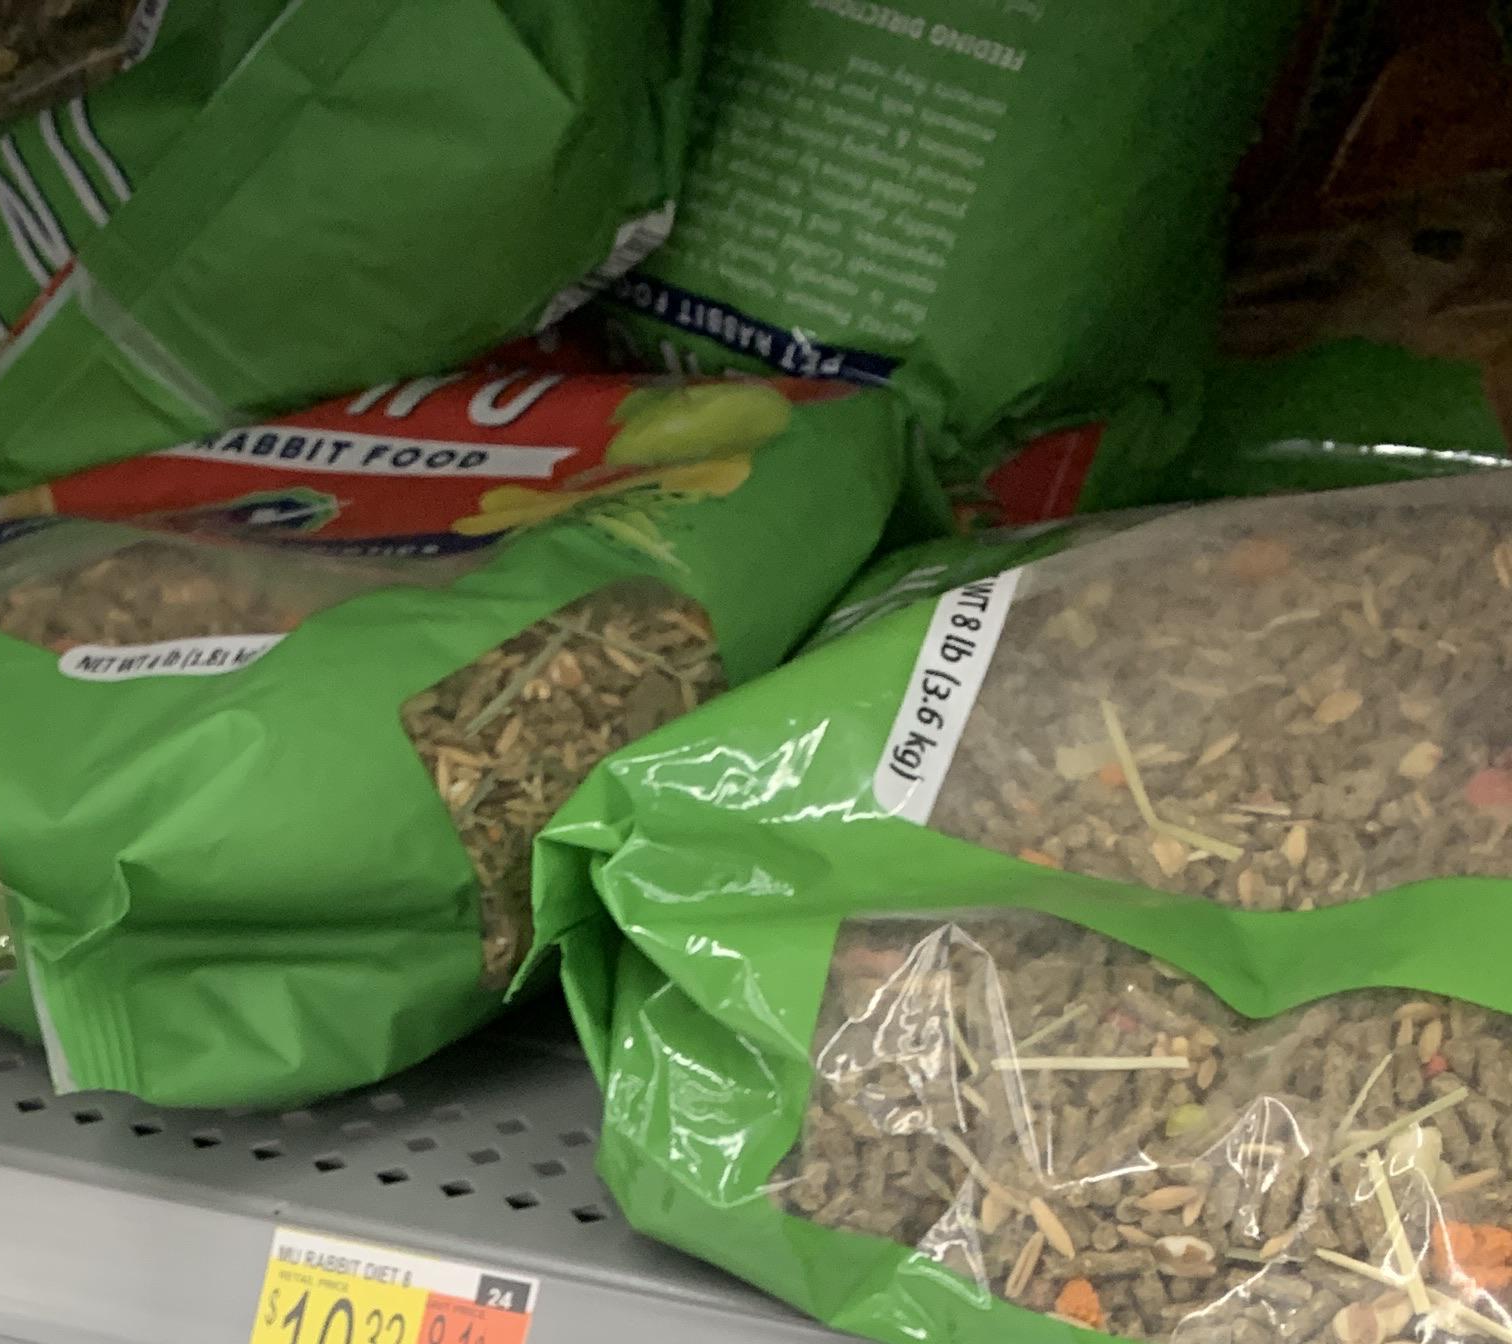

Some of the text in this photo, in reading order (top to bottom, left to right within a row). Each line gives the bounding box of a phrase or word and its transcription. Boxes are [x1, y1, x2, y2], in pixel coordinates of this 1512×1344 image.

[362, 446, 490, 470] FOOD
[950, 614, 982, 631] 8
[941, 634, 977, 662] lb
[915, 669, 962, 730] (3.6
[888, 731, 938, 782] kg)
[303, 1250, 362, 1278] RABBIT
[364, 1262, 400, 1286] DIET
[485, 1287, 512, 1310] 24
